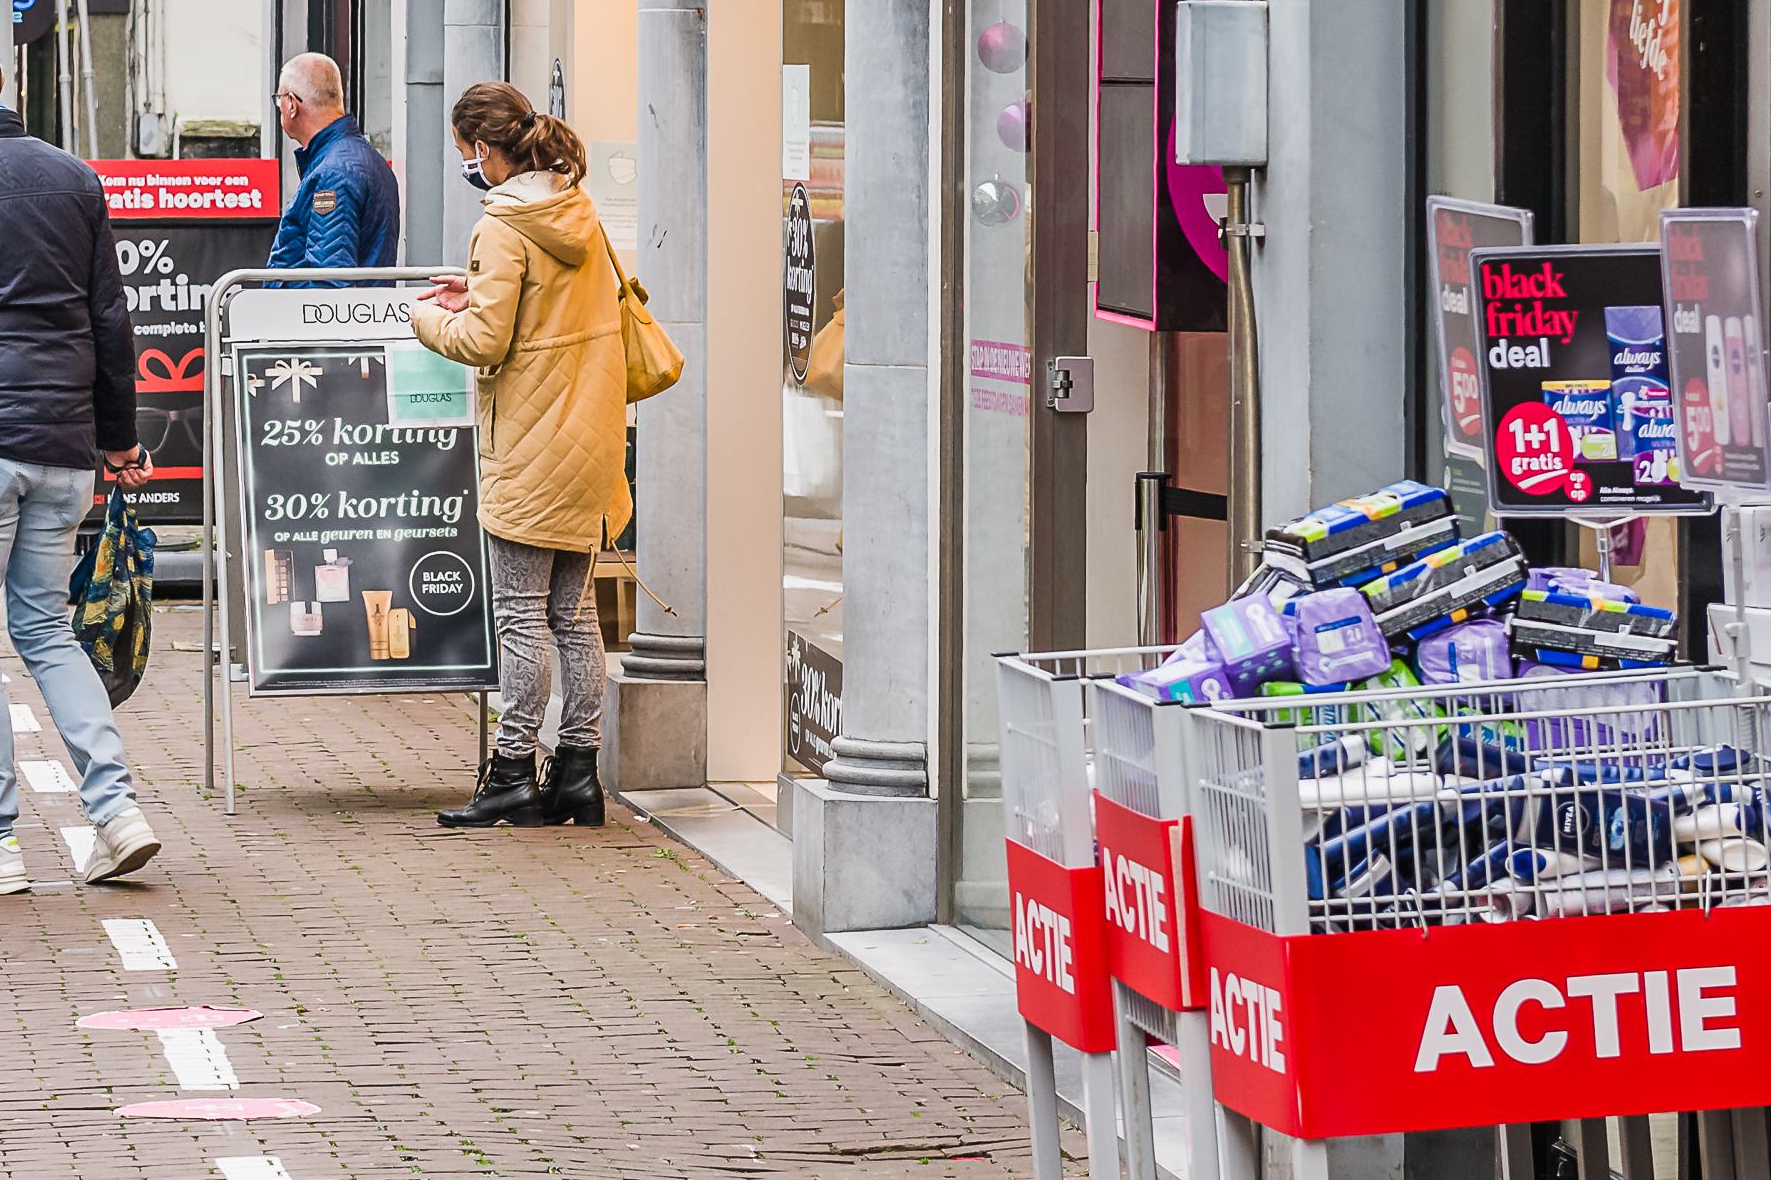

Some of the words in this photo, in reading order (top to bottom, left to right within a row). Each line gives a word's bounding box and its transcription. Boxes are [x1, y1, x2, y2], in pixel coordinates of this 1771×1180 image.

[99, 175, 126, 186] Kom
[128, 177, 145, 186] nu
[147, 174, 191, 186] binnen
[193, 176, 223, 186] voor
[224, 175, 249, 186] een
[104, 189, 154, 209] ratis
[159, 188, 262, 209] hoortest
[115, 239, 174, 276] 0%
[123, 274, 242, 313] ortin
[1480, 261, 1568, 301] black
[1441, 283, 1469, 315] deal
[302, 302, 411, 324] DOUGLAS
[1485, 301, 1578, 344] friday
[1674, 303, 1701, 333] deal
[133, 322, 198, 337] complete
[1489, 338, 1551, 370] deal
[1614, 348, 1661, 370] always
[410, 393, 452, 404] DOUGLAS
[1553, 395, 1607, 421] always
[261, 419, 325, 446] 25%
[1508, 417, 1560, 454] 1+1
[1638, 419, 1677, 439] alwa
[325, 452, 349, 466] OP
[352, 451, 400, 465] ALLES
[1511, 448, 1563, 475] gratis
[139, 492, 180, 504] ANDERS
[264, 492, 331, 520] 30%
[274, 532, 291, 542] OP
[292, 530, 319, 541] ALLE
[320, 528, 374, 544] geuren
[376, 530, 392, 539] EN
[393, 526, 458, 541] geursets
[422, 571, 461, 582] BLACK
[422, 583, 463, 594] FRIDAY
[821, 671, 844, 736] kort
[1563, 805, 1575, 833] NIVEA
[1103, 846, 1170, 955] ACTIE
[1014, 891, 1075, 996] ACTIE
[1210, 966, 1286, 1075] ACTIE
[1413, 965, 1742, 1073] ACTIE
